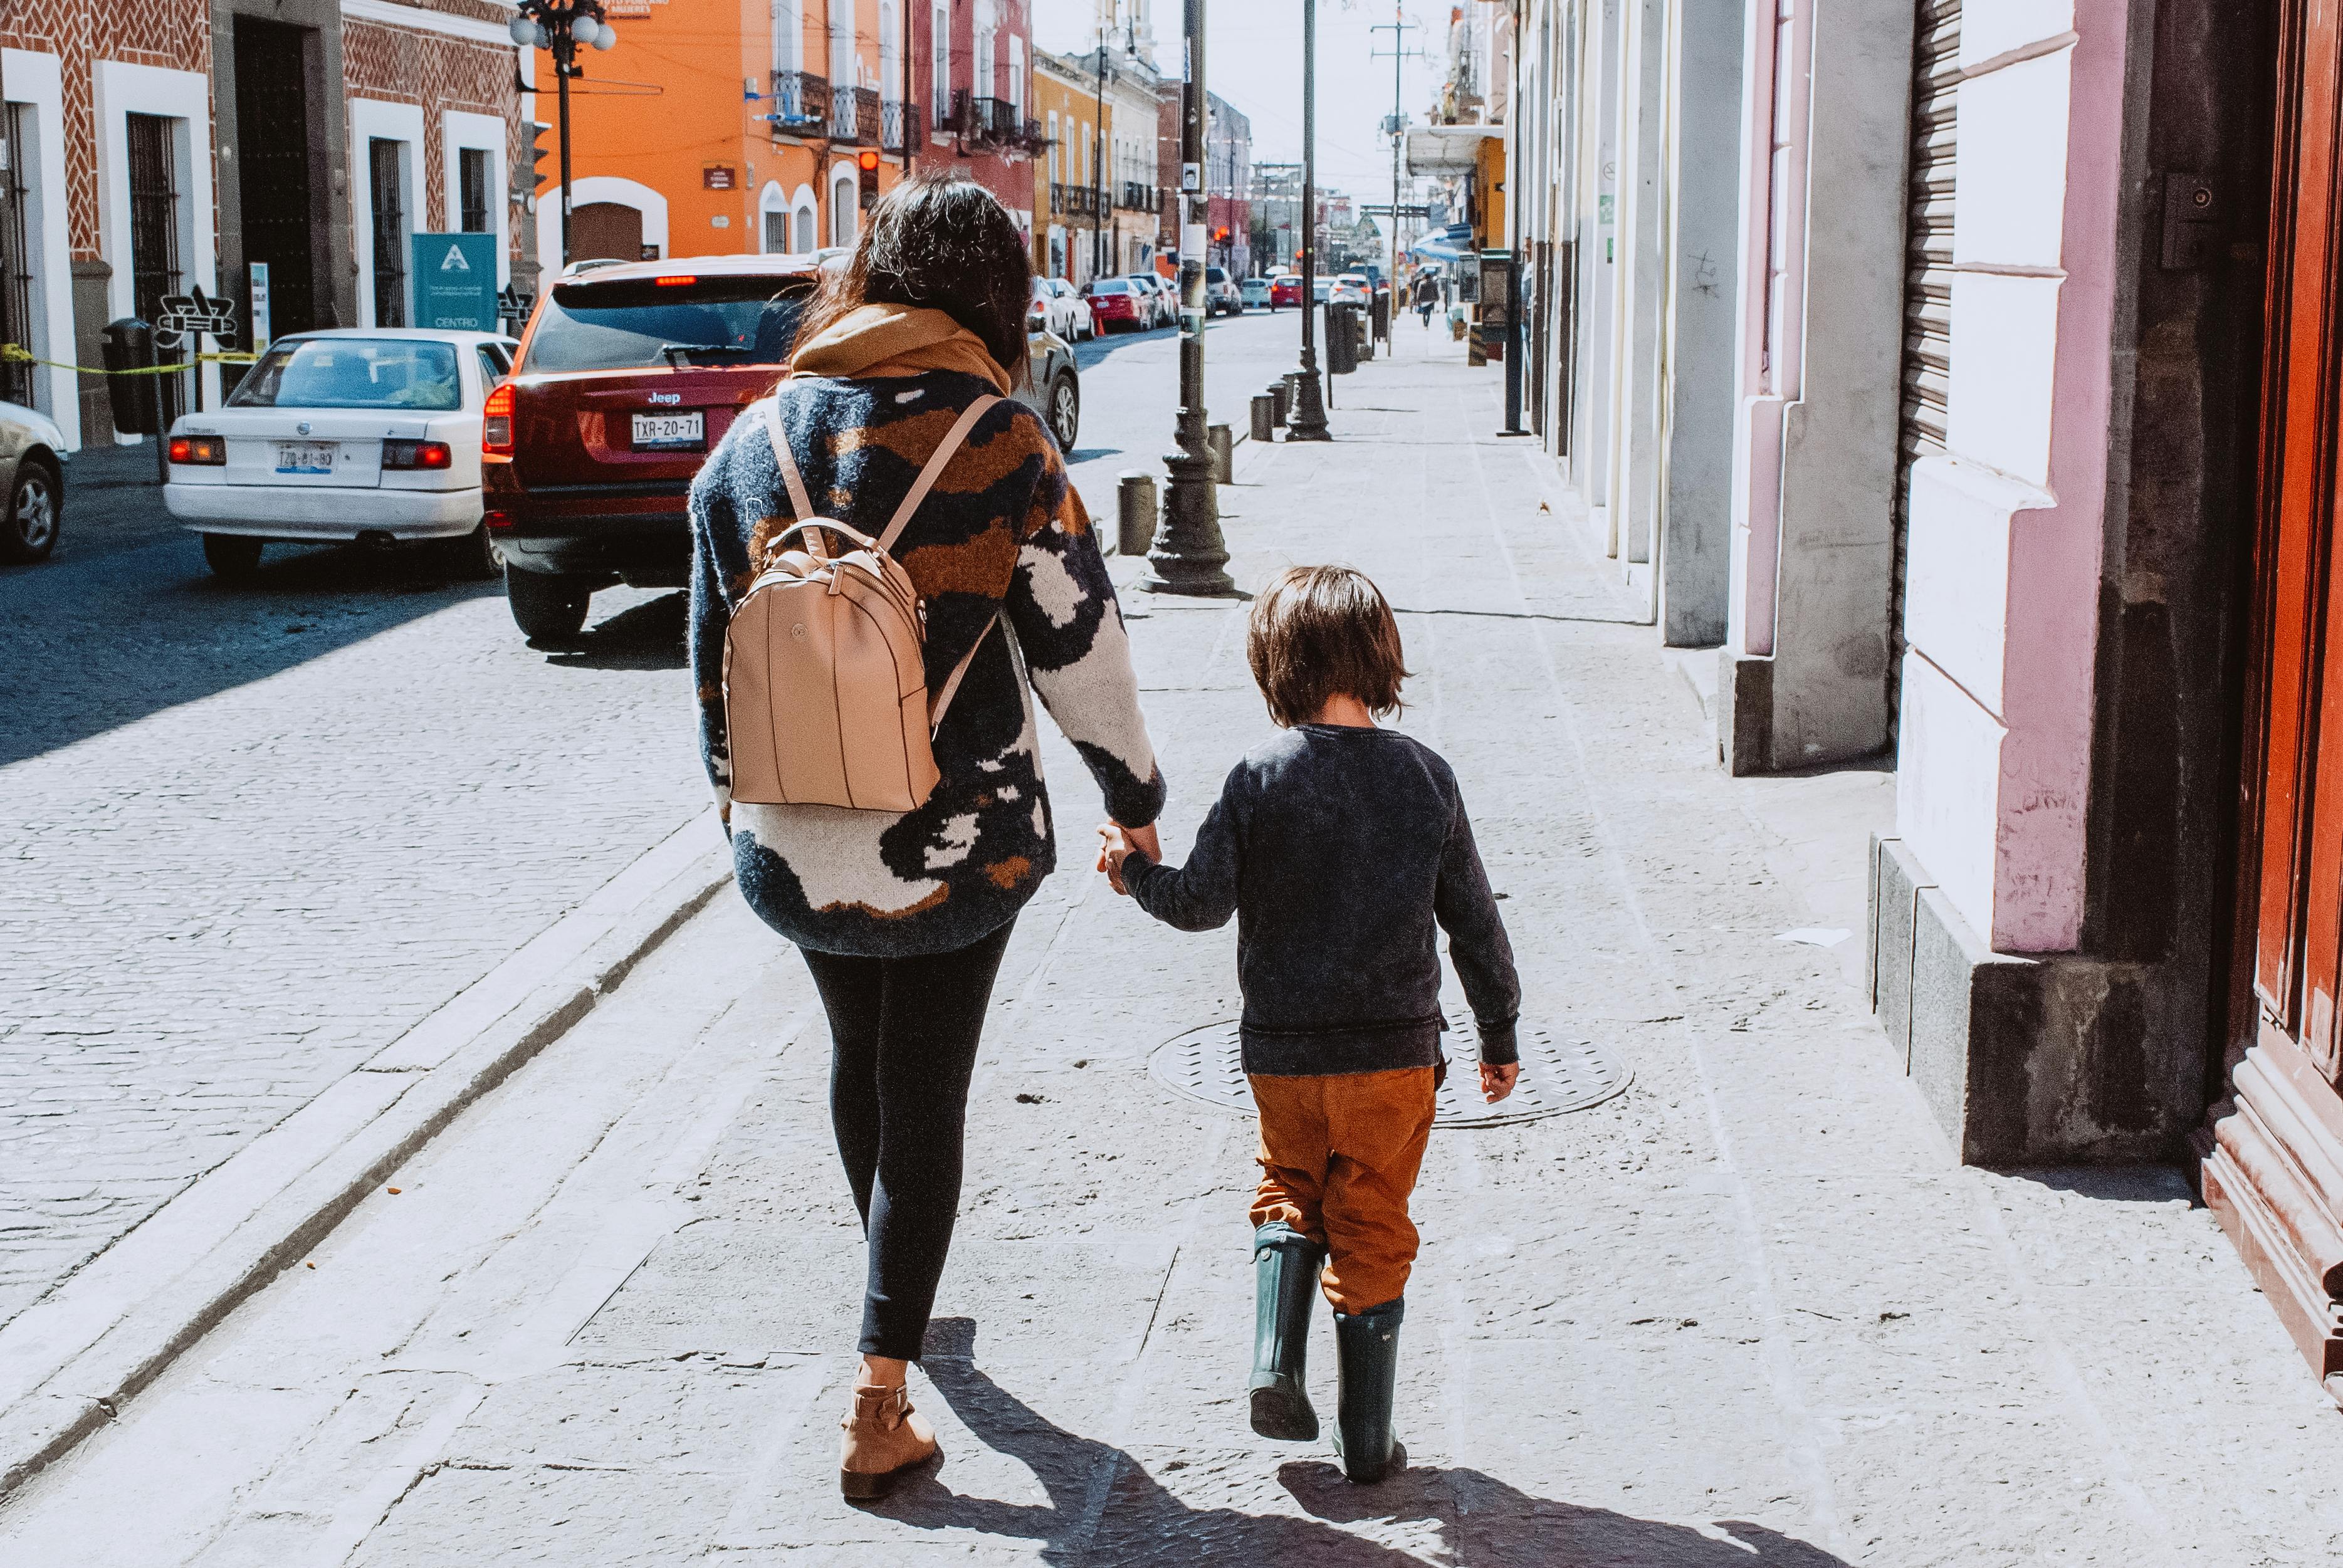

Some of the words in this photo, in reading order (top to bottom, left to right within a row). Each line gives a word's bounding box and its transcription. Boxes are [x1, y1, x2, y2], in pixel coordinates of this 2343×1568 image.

[435, 317, 478, 327] CENTRO
[647, 392, 681, 405] Jeep
[634, 419, 700, 437] TXR-20-71
